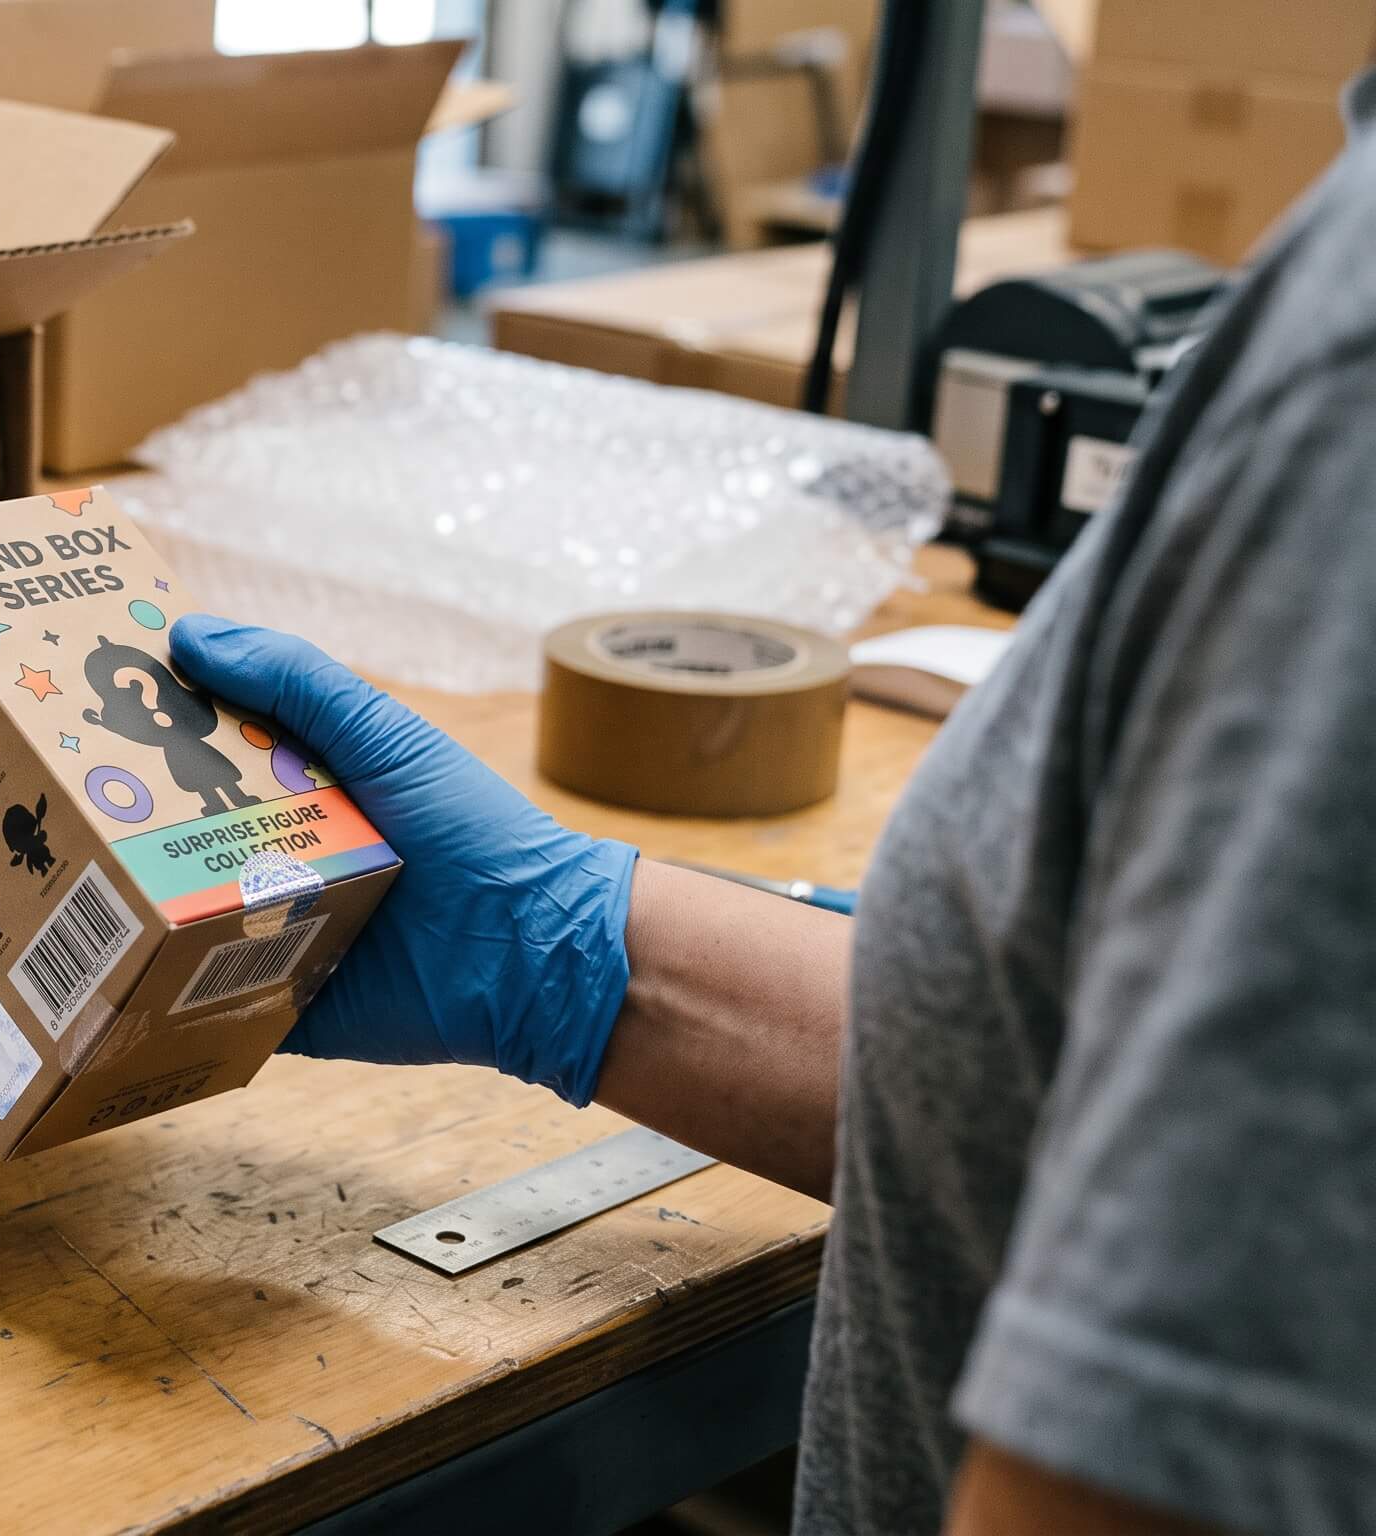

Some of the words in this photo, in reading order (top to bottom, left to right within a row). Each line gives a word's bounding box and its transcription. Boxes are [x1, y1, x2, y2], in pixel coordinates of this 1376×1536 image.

[44, 525, 132, 561] BOX
[163, 820, 258, 859] SURPRISE
[256, 803, 327, 833] FIGURE
